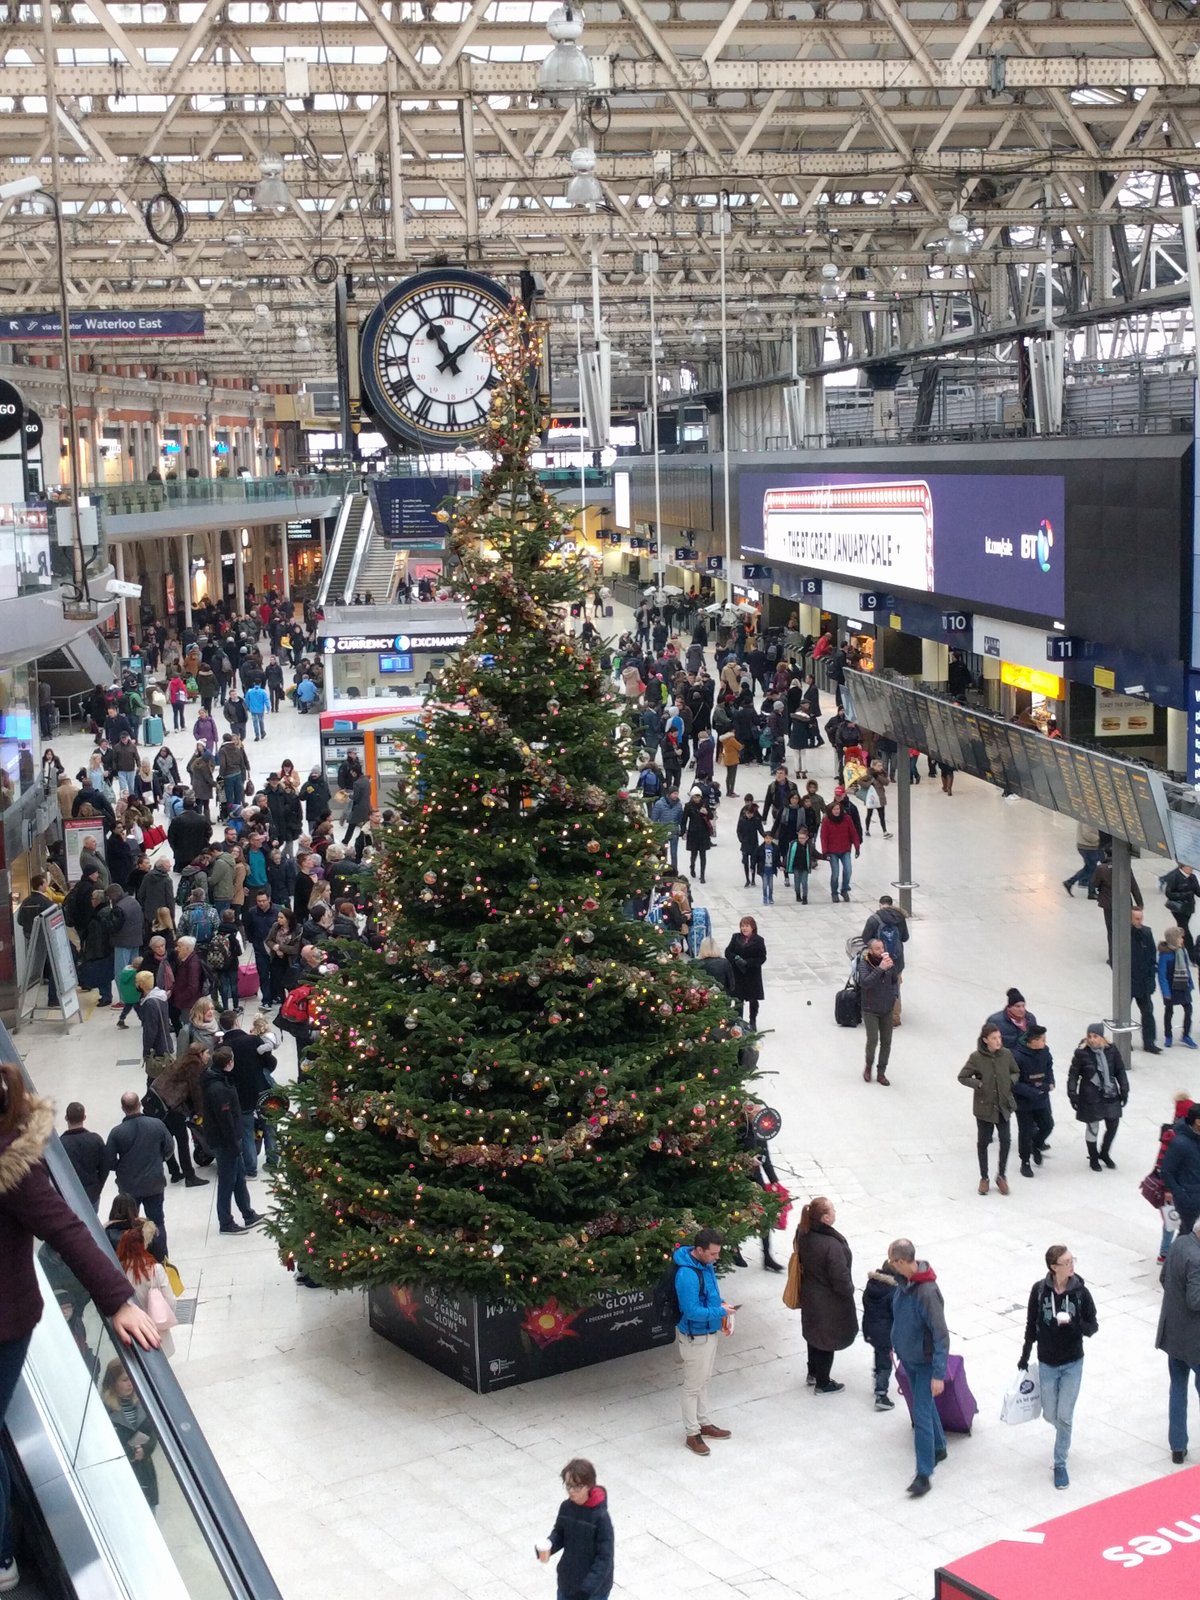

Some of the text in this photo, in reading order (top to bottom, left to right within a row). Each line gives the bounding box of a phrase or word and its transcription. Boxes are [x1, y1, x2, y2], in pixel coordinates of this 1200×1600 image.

[85, 318, 136, 330] Waterloo
[138, 318, 162, 329] East
[612, 534, 618, 542] 2
[632, 539, 638, 547] 3
[788, 531, 800, 558] THE
[801, 531, 809, 559] BT
[833, 532, 869, 565] JANUARY
[871, 534, 892, 567] SALE
[1021, 534, 1038, 559] BT
[678, 550, 684, 559] 5
[710, 558, 718, 567] 6
[747, 567, 755, 577] 7
[807, 581, 815, 593] 8
[867, 596, 877, 608] 9
[949, 616, 966, 630] 10
[337, 638, 394, 650] CURRENCY
[1058, 641, 1072, 657] 11
[606, 1291, 645, 1309] GLOWS
[440, 1304, 467, 1327] GARDEN
[434, 1311, 458, 1333] GLOWS
